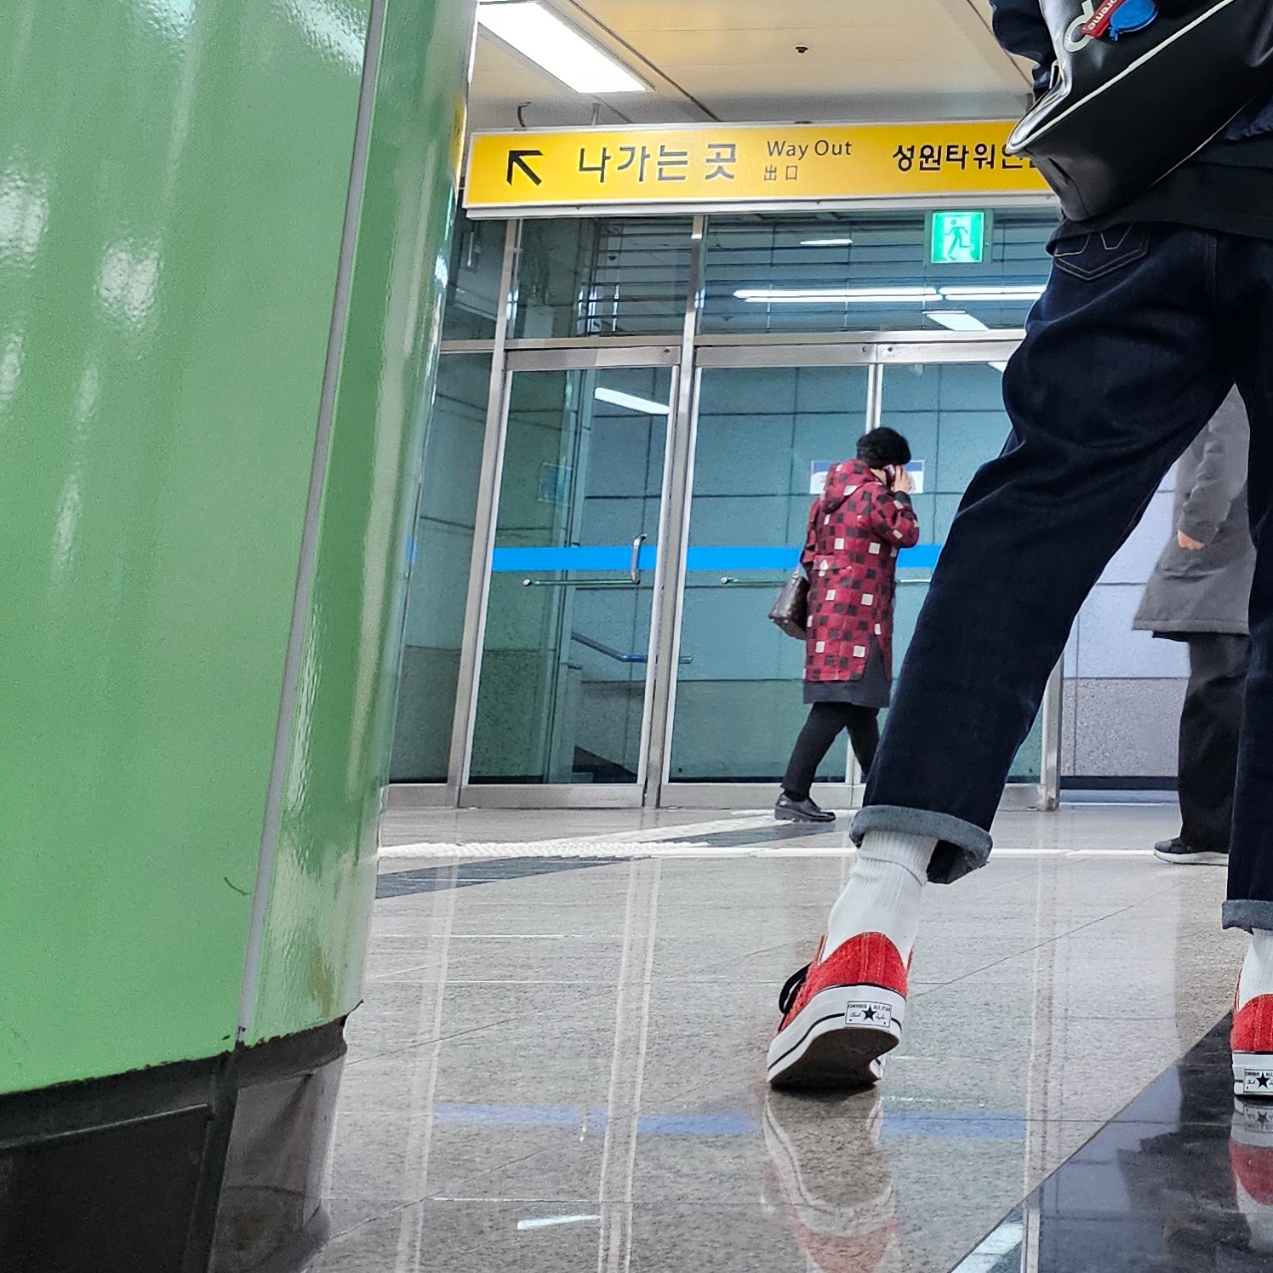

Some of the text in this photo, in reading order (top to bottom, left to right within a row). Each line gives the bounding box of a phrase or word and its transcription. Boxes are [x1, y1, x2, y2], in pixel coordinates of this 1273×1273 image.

[578, 142, 736, 183] 나가는 곳
[767, 139, 853, 161] Way Out
[892, 142, 1040, 172] 성원타워
[763, 164, 798, 181] 出口
